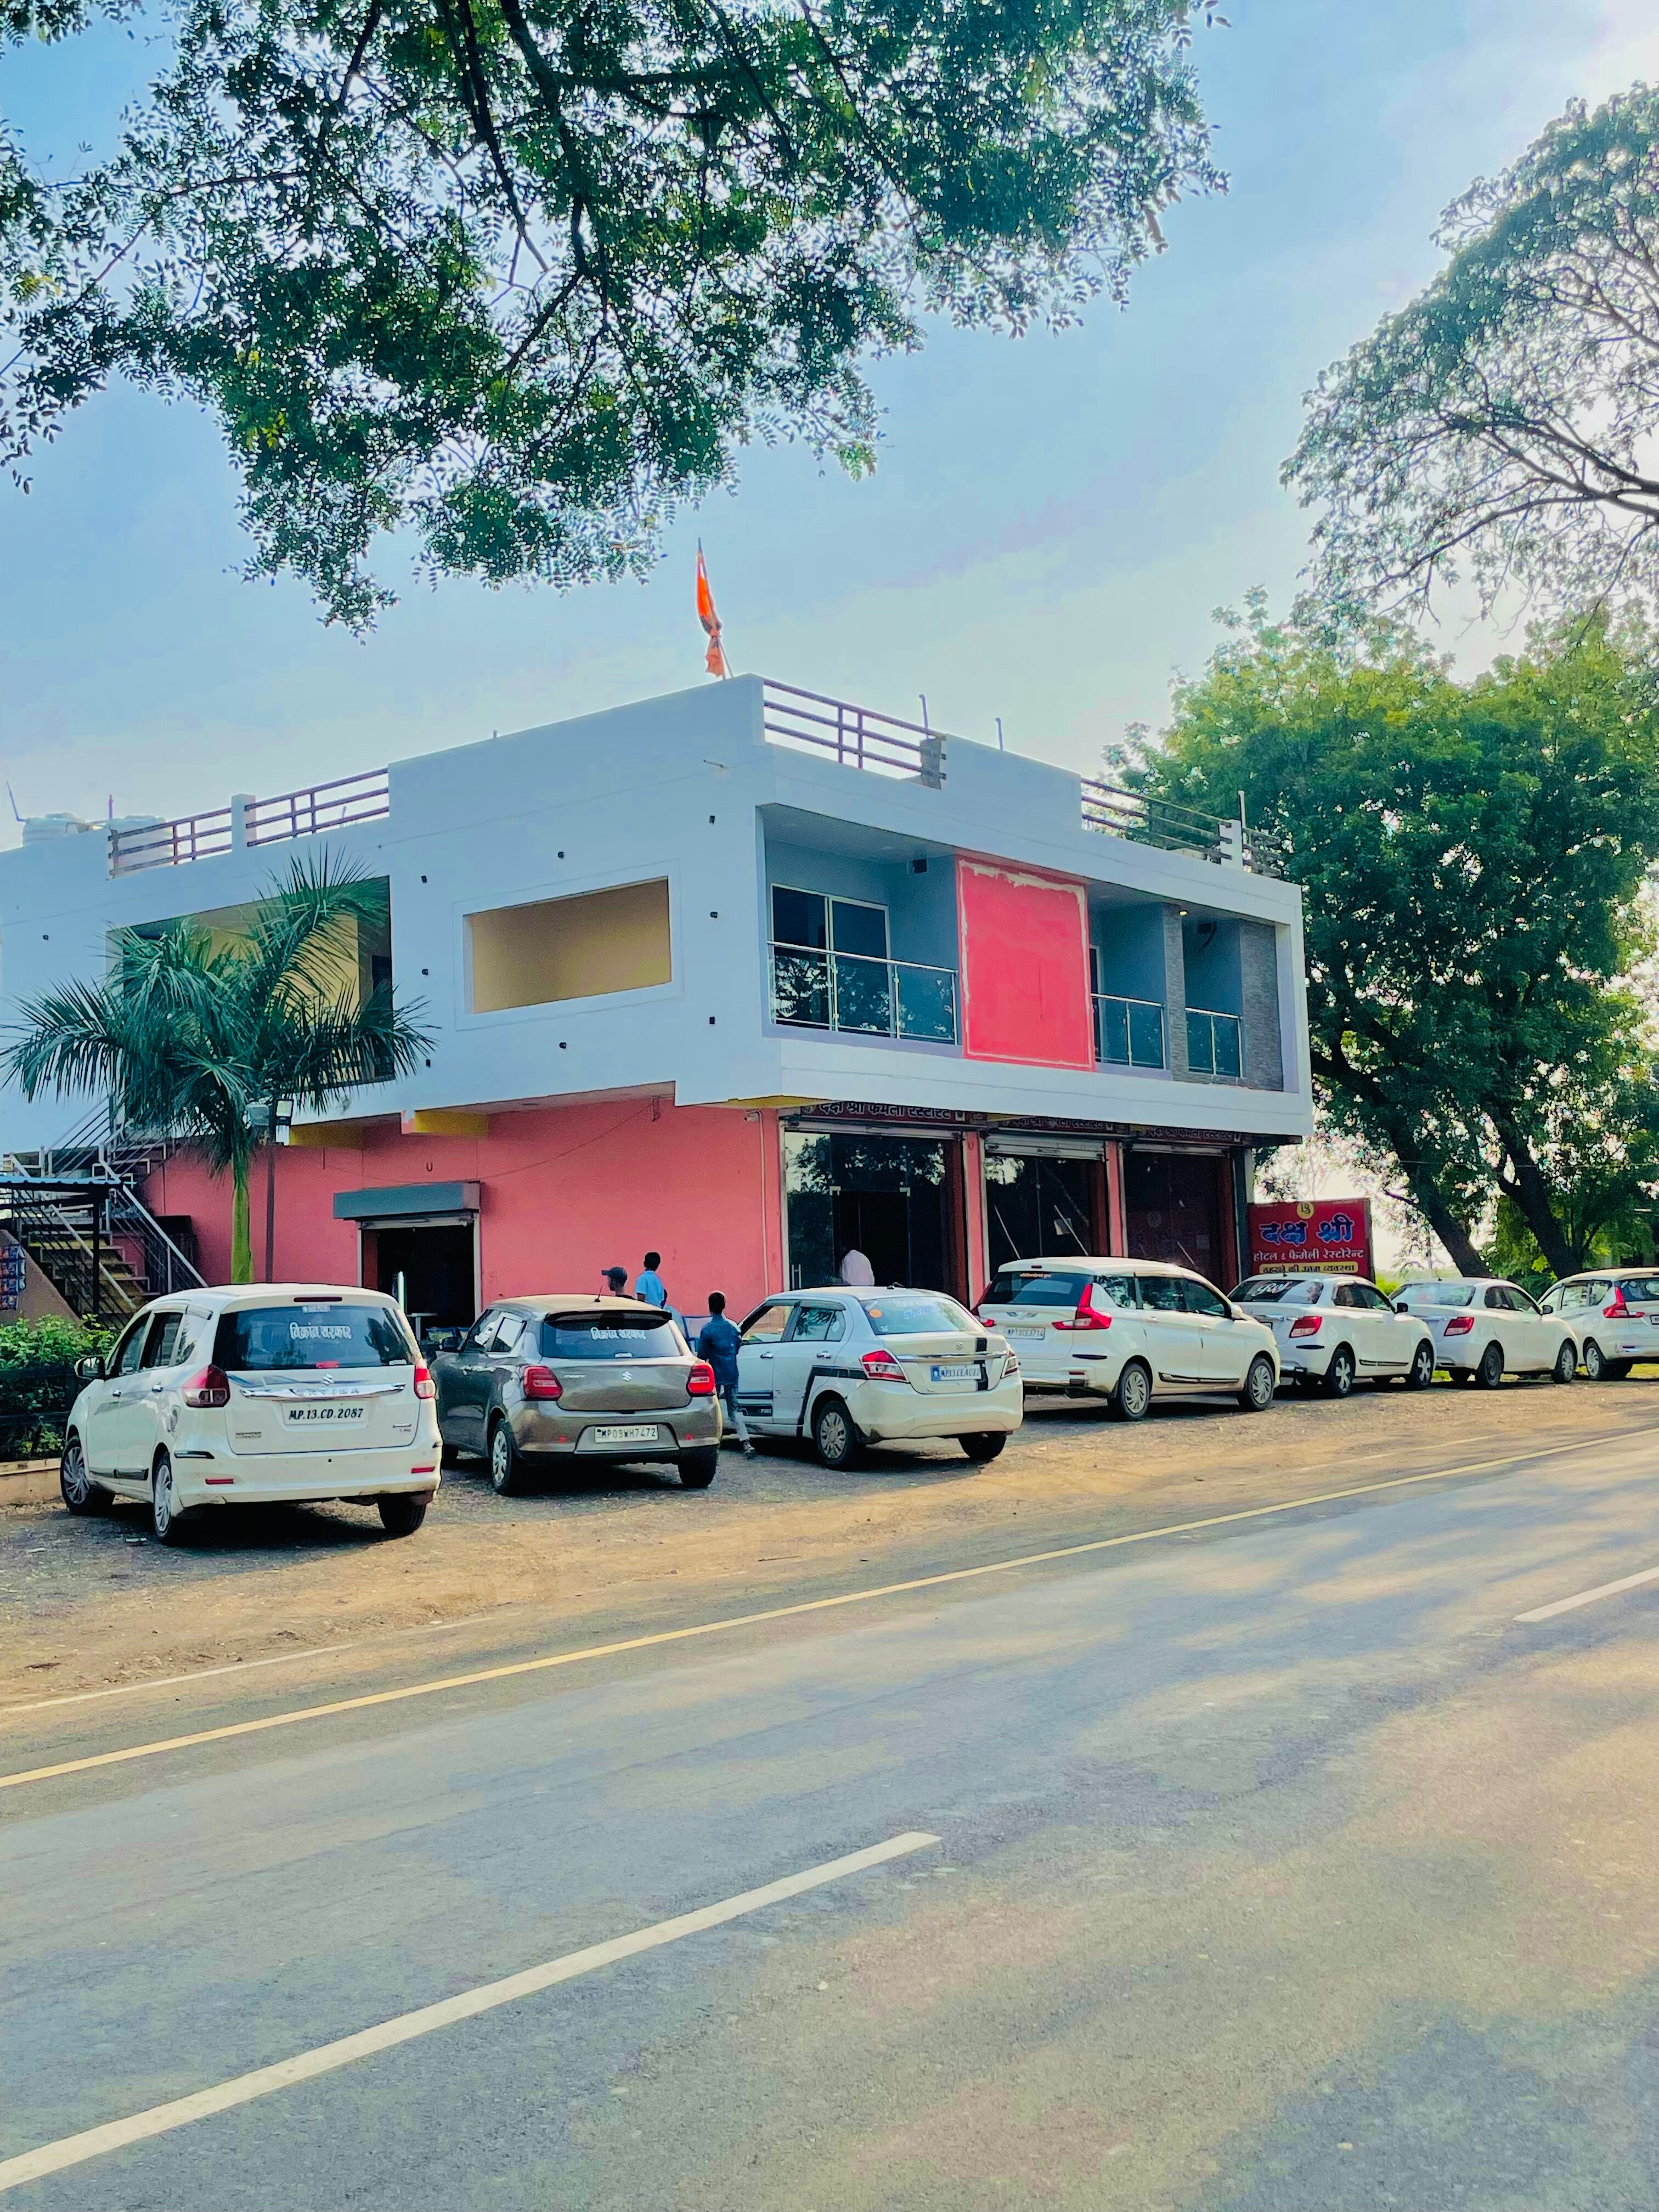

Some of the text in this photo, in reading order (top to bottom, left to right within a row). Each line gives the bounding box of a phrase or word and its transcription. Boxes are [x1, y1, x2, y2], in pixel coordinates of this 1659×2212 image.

[1259, 1213, 1355, 1246] दक्ष श्री
[1254, 1250, 1277, 1261] होटल
